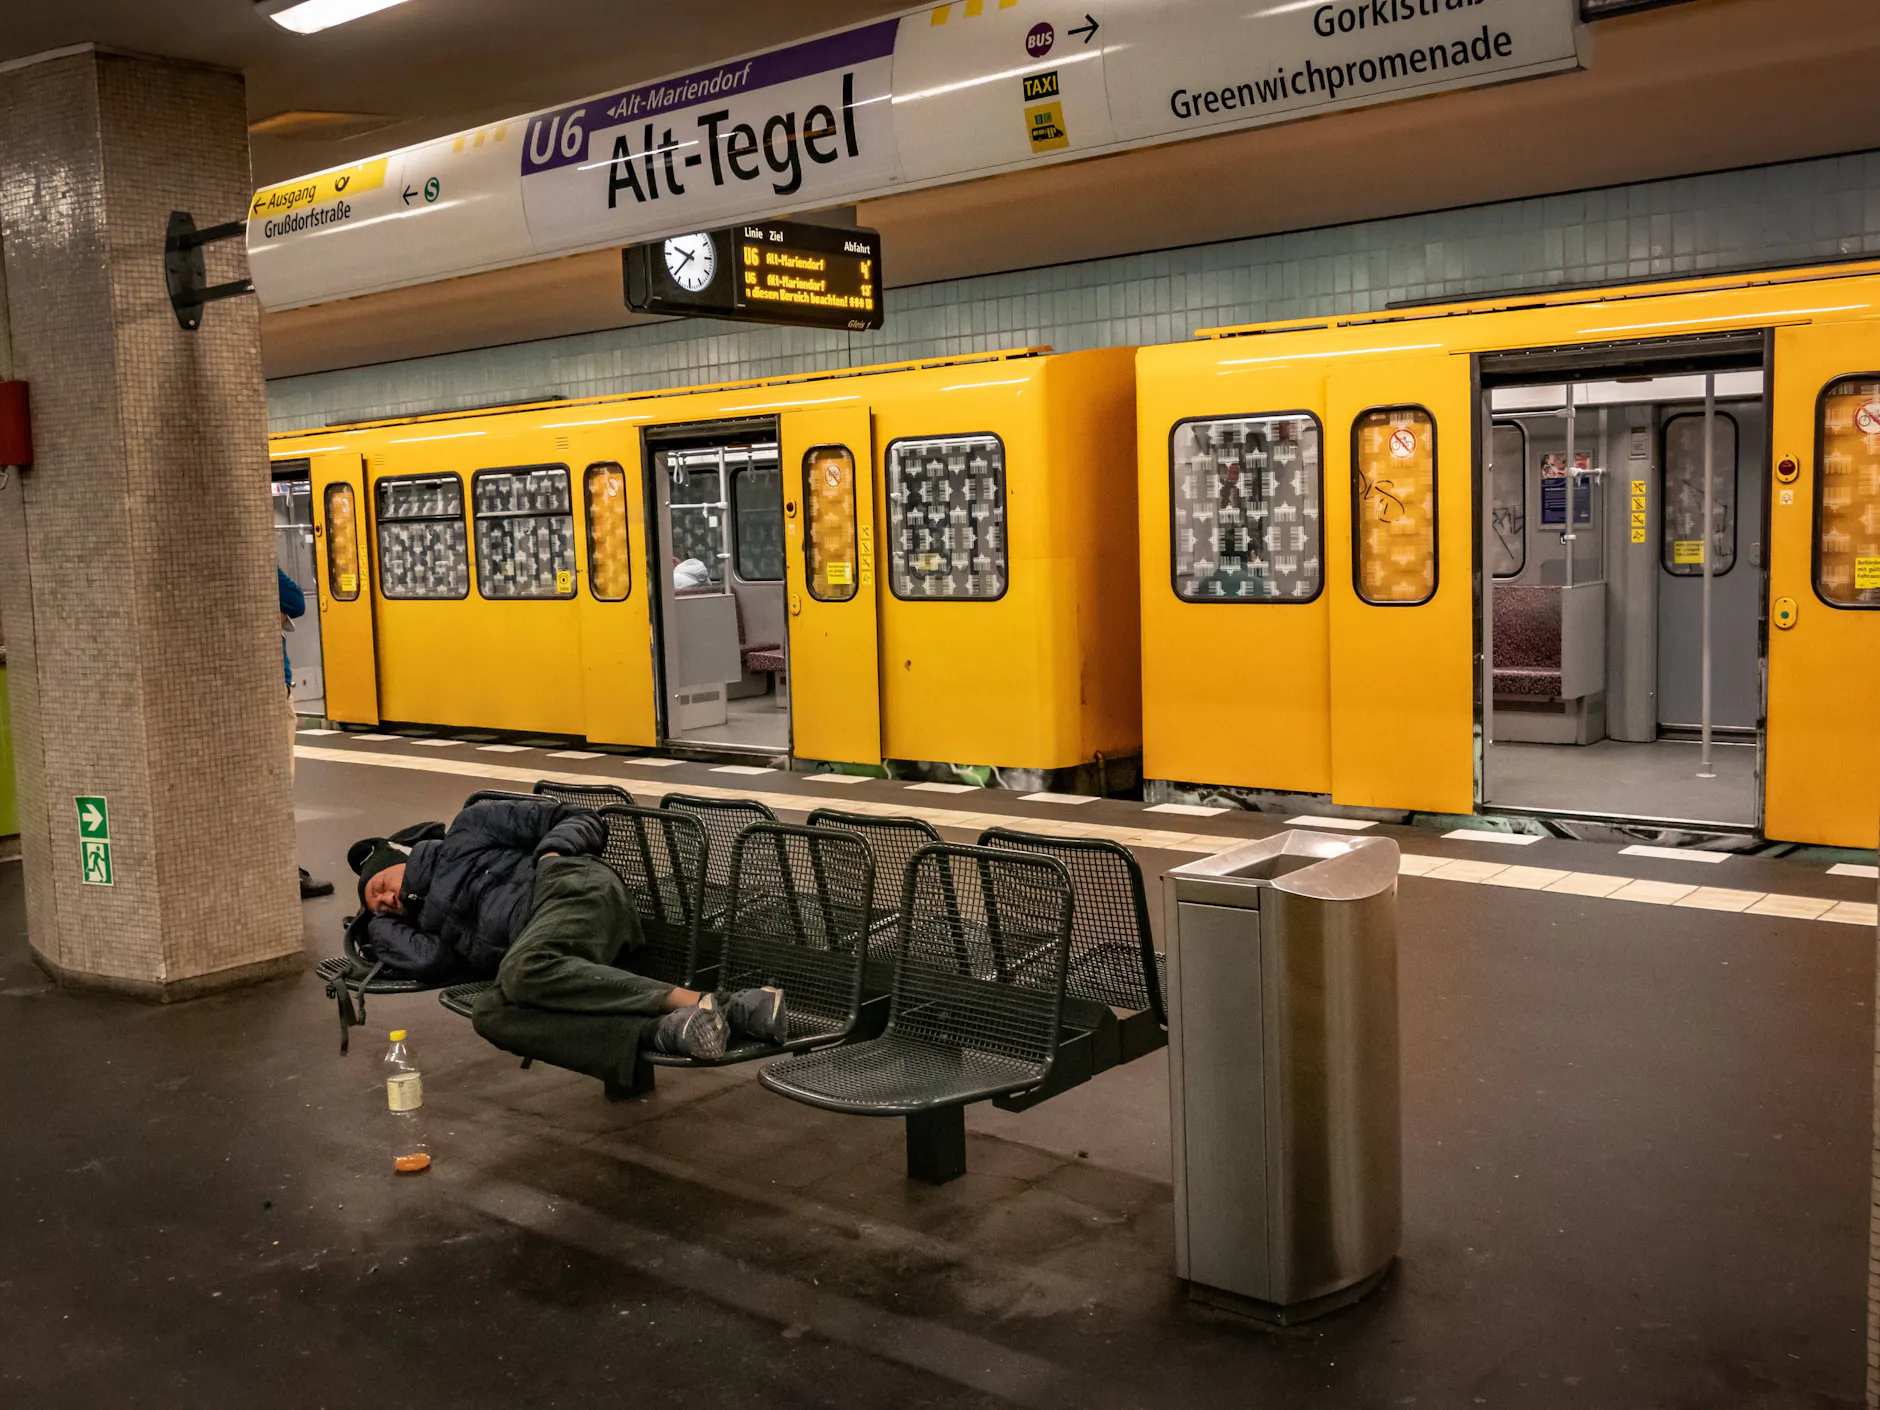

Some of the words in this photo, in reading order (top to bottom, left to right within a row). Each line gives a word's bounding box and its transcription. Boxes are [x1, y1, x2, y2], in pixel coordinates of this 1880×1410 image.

[1027, 31, 1053, 50] BUS
[1170, 25, 1513, 119] Greenwichpromenade
[614, 62, 753, 119] Alt-Mariendorf
[1024, 75, 1057, 97] TAXI
[529, 109, 587, 166] U6
[608, 72, 859, 209] Alt-Tegel
[267, 185, 317, 210] Ausgang
[265, 200, 351, 238] Grußdorfstraße
[744, 227, 763, 240] Linie
[769, 231, 784, 242] Ziel
[844, 241, 871, 255] Abfahrt
[743, 246, 760, 266] U6
[766, 252, 824, 271] Alt-Mariendorf
[744, 271, 758, 285] U6
[767, 274, 826, 292] Alt-Mariendorf
[780, 289, 809, 304] Bereich
[848, 319, 865, 329] Gleis
